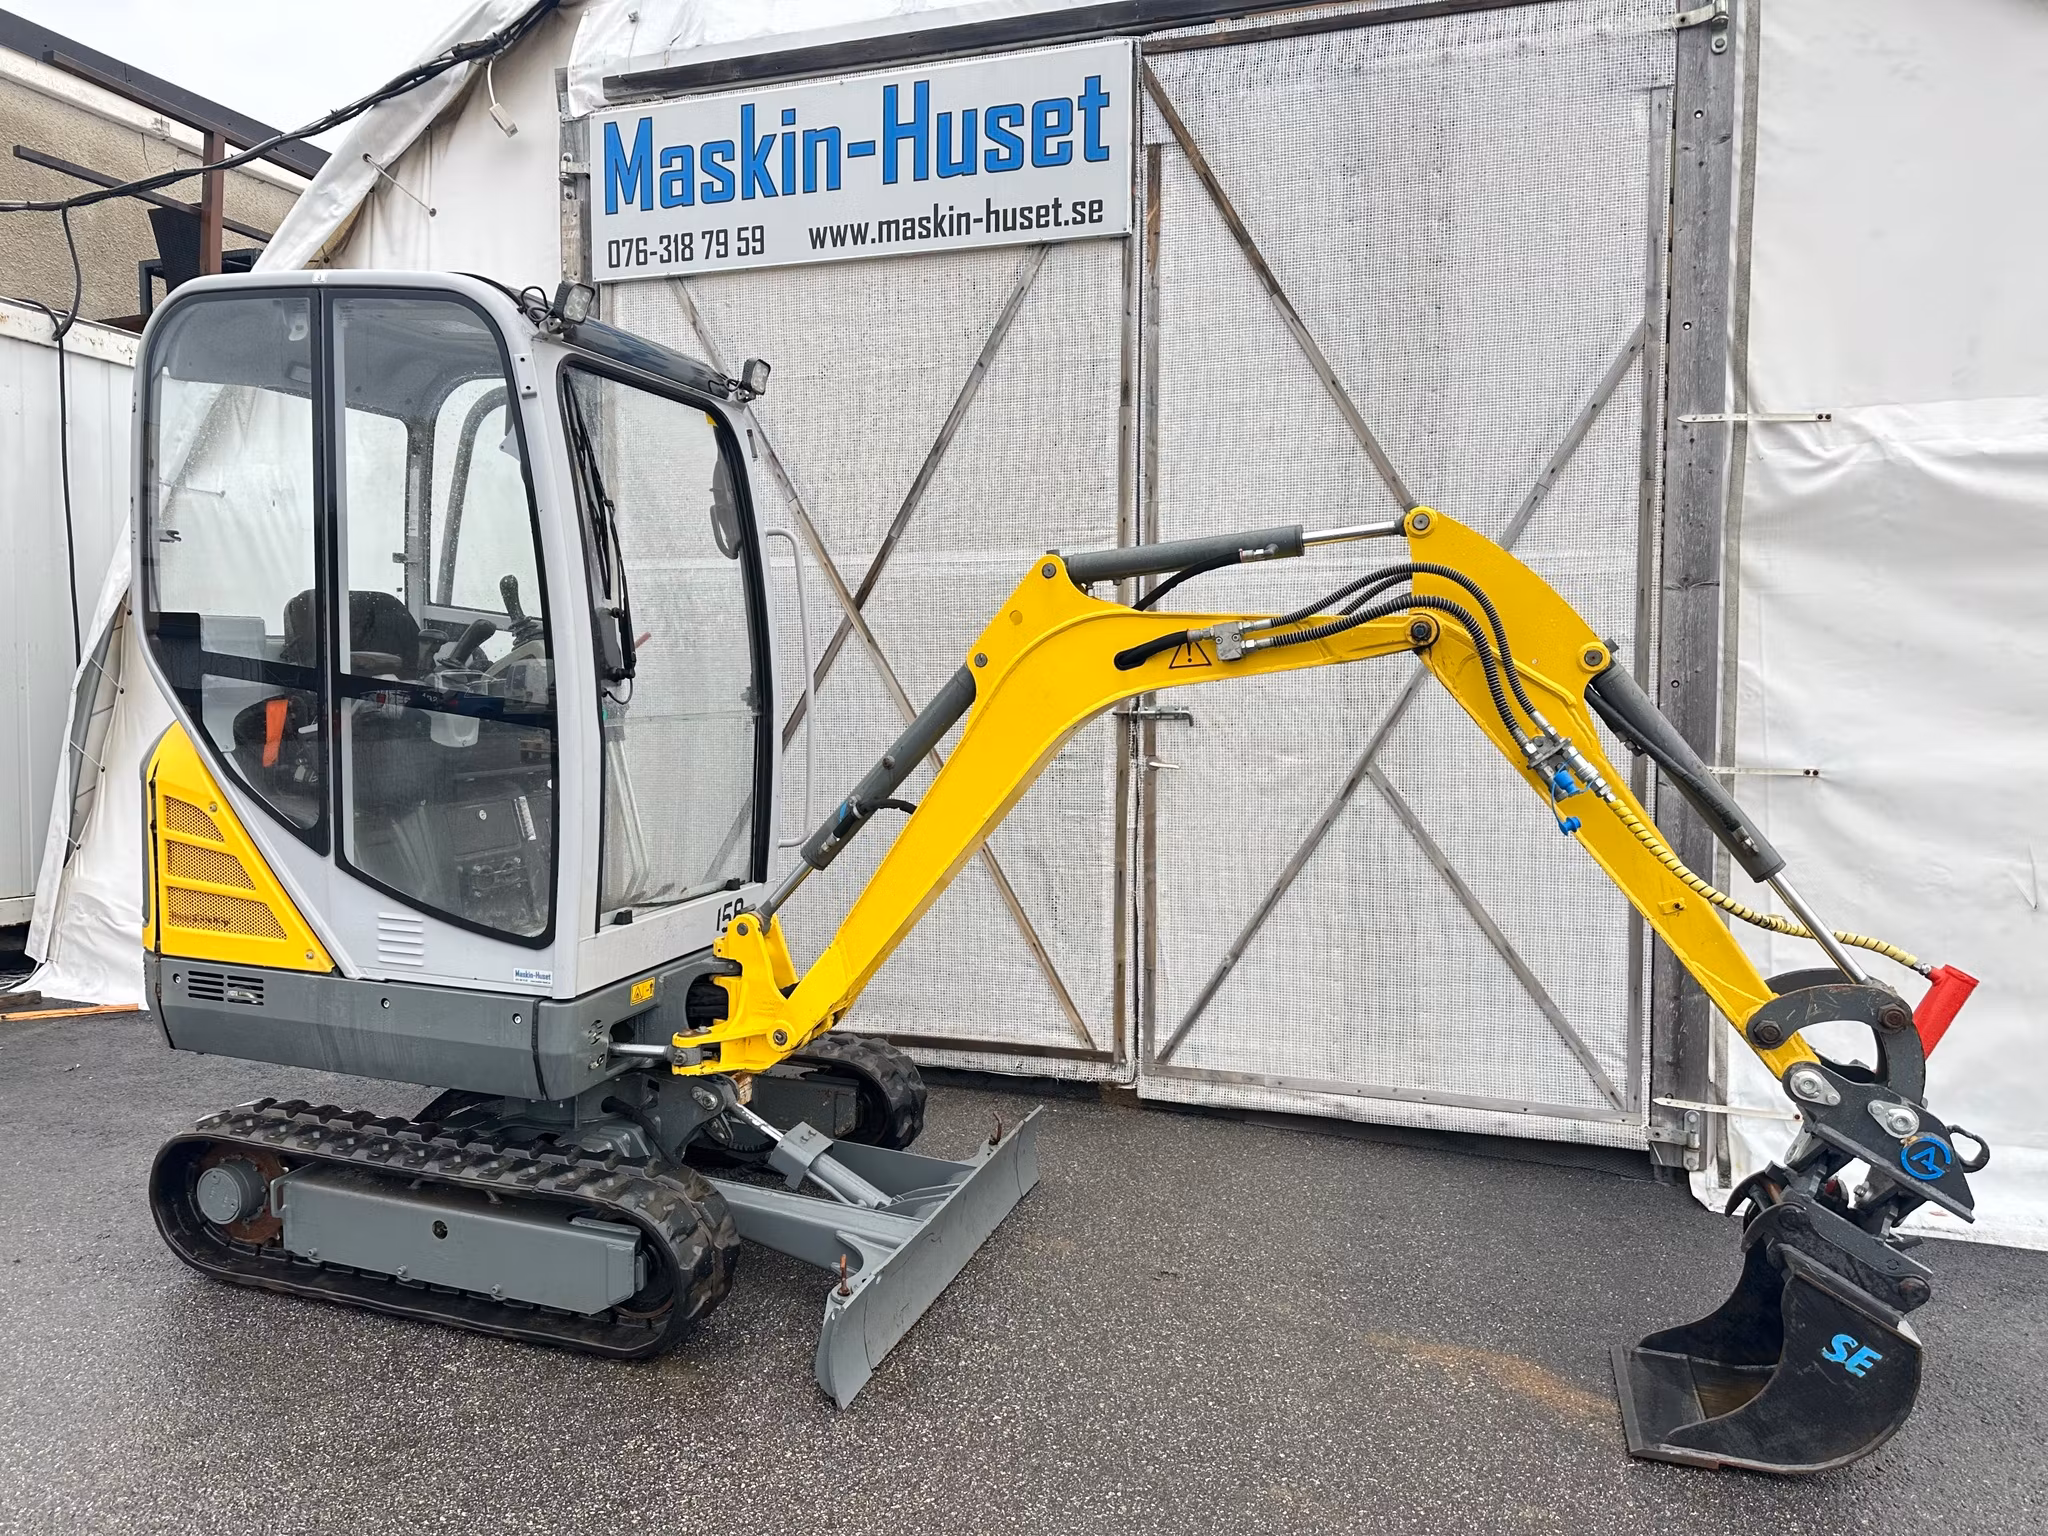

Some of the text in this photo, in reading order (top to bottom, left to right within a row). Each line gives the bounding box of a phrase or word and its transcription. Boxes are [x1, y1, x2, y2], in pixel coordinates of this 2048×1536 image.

[603, 75, 1111, 215] Maskin-Huset
[608, 225, 765, 268] 076-318 79 59
[808, 197, 1104, 250] www.maskin-huset.se
[1821, 1333, 1883, 1378] SE
